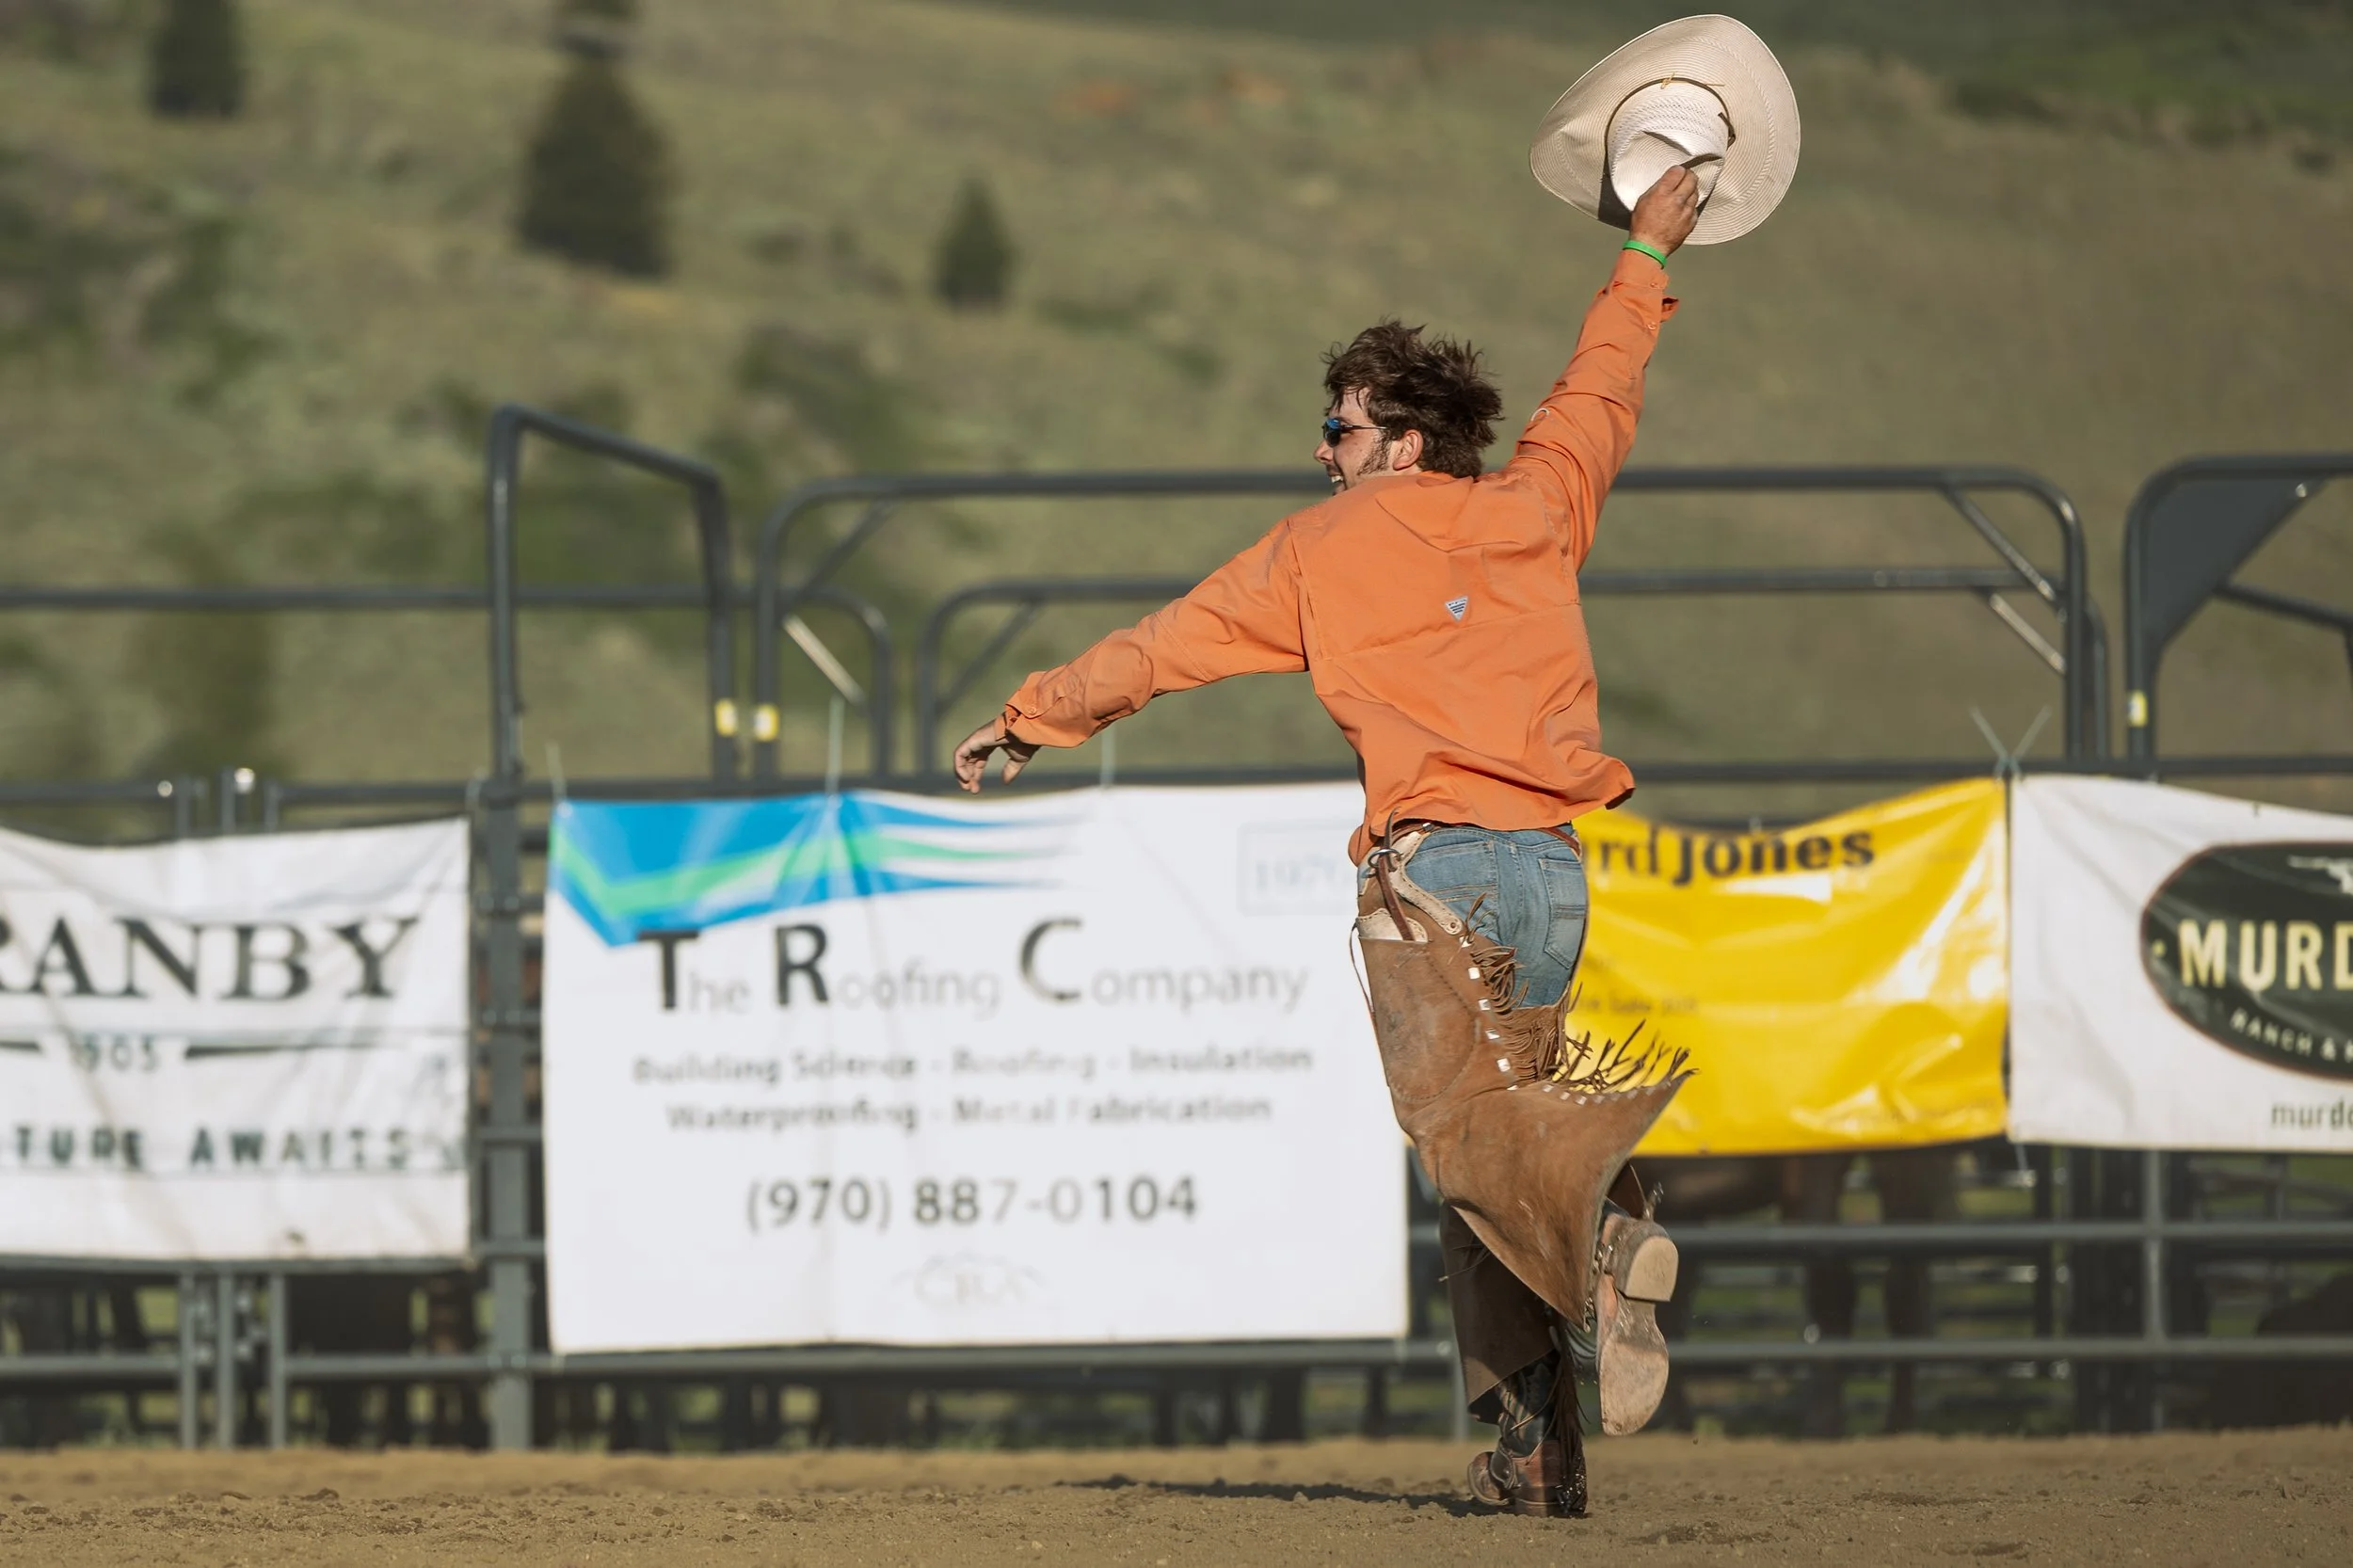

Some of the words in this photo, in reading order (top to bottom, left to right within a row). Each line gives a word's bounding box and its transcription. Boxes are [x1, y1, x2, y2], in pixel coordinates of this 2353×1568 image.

[0, 915, 420, 1000] ANBY
[636, 928, 750, 1013] The
[775, 922, 1001, 1020] Roofing
[1020, 915, 1309, 1015] Company
[1129, 1044, 1313, 1073] Insulation
[188, 1127, 412, 1170] AWAITS
[745, 1176, 891, 1234] (970)
[914, 1175, 1197, 1224] 887-0104
